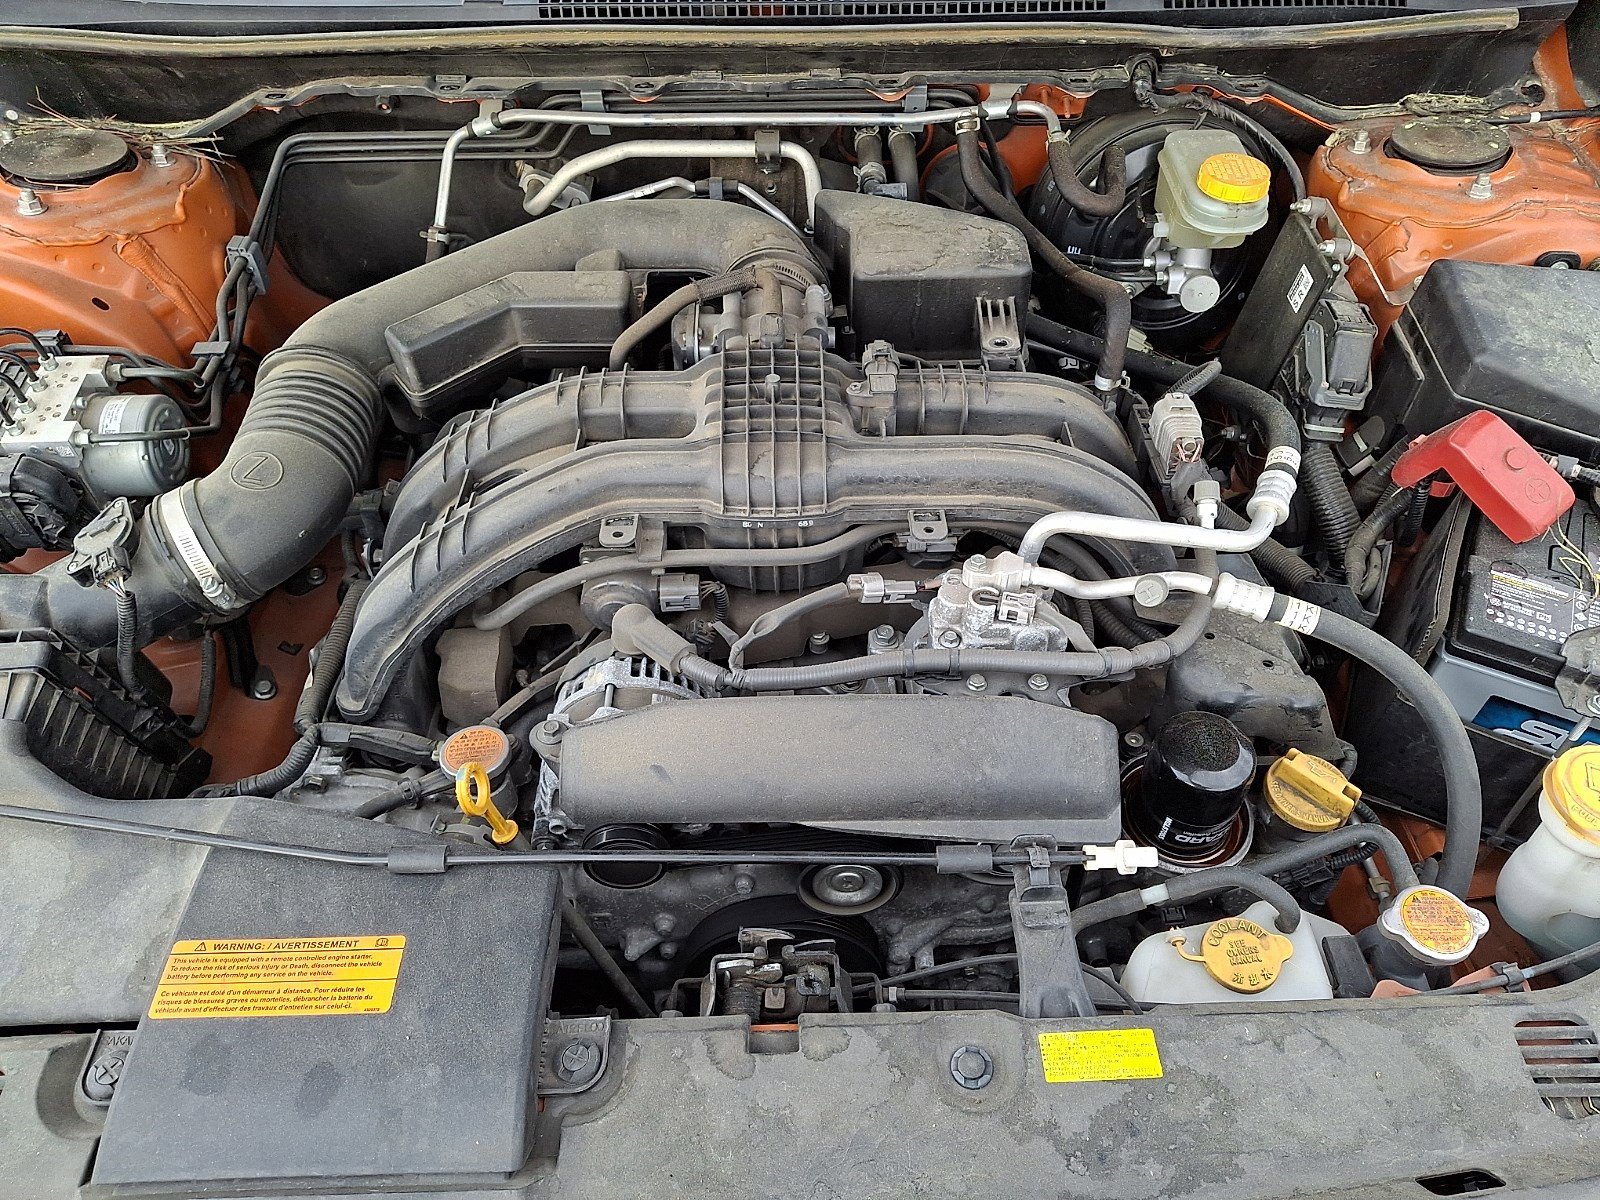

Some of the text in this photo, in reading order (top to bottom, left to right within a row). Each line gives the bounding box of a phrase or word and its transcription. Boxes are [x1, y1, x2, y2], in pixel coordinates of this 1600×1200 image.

[1208, 920, 1268, 946] COOLANT
[273, 940, 359, 950] AVERTISSEMENT
[1228, 939, 1246, 948] SEE
[1229, 954, 1262, 966] MANUAL
